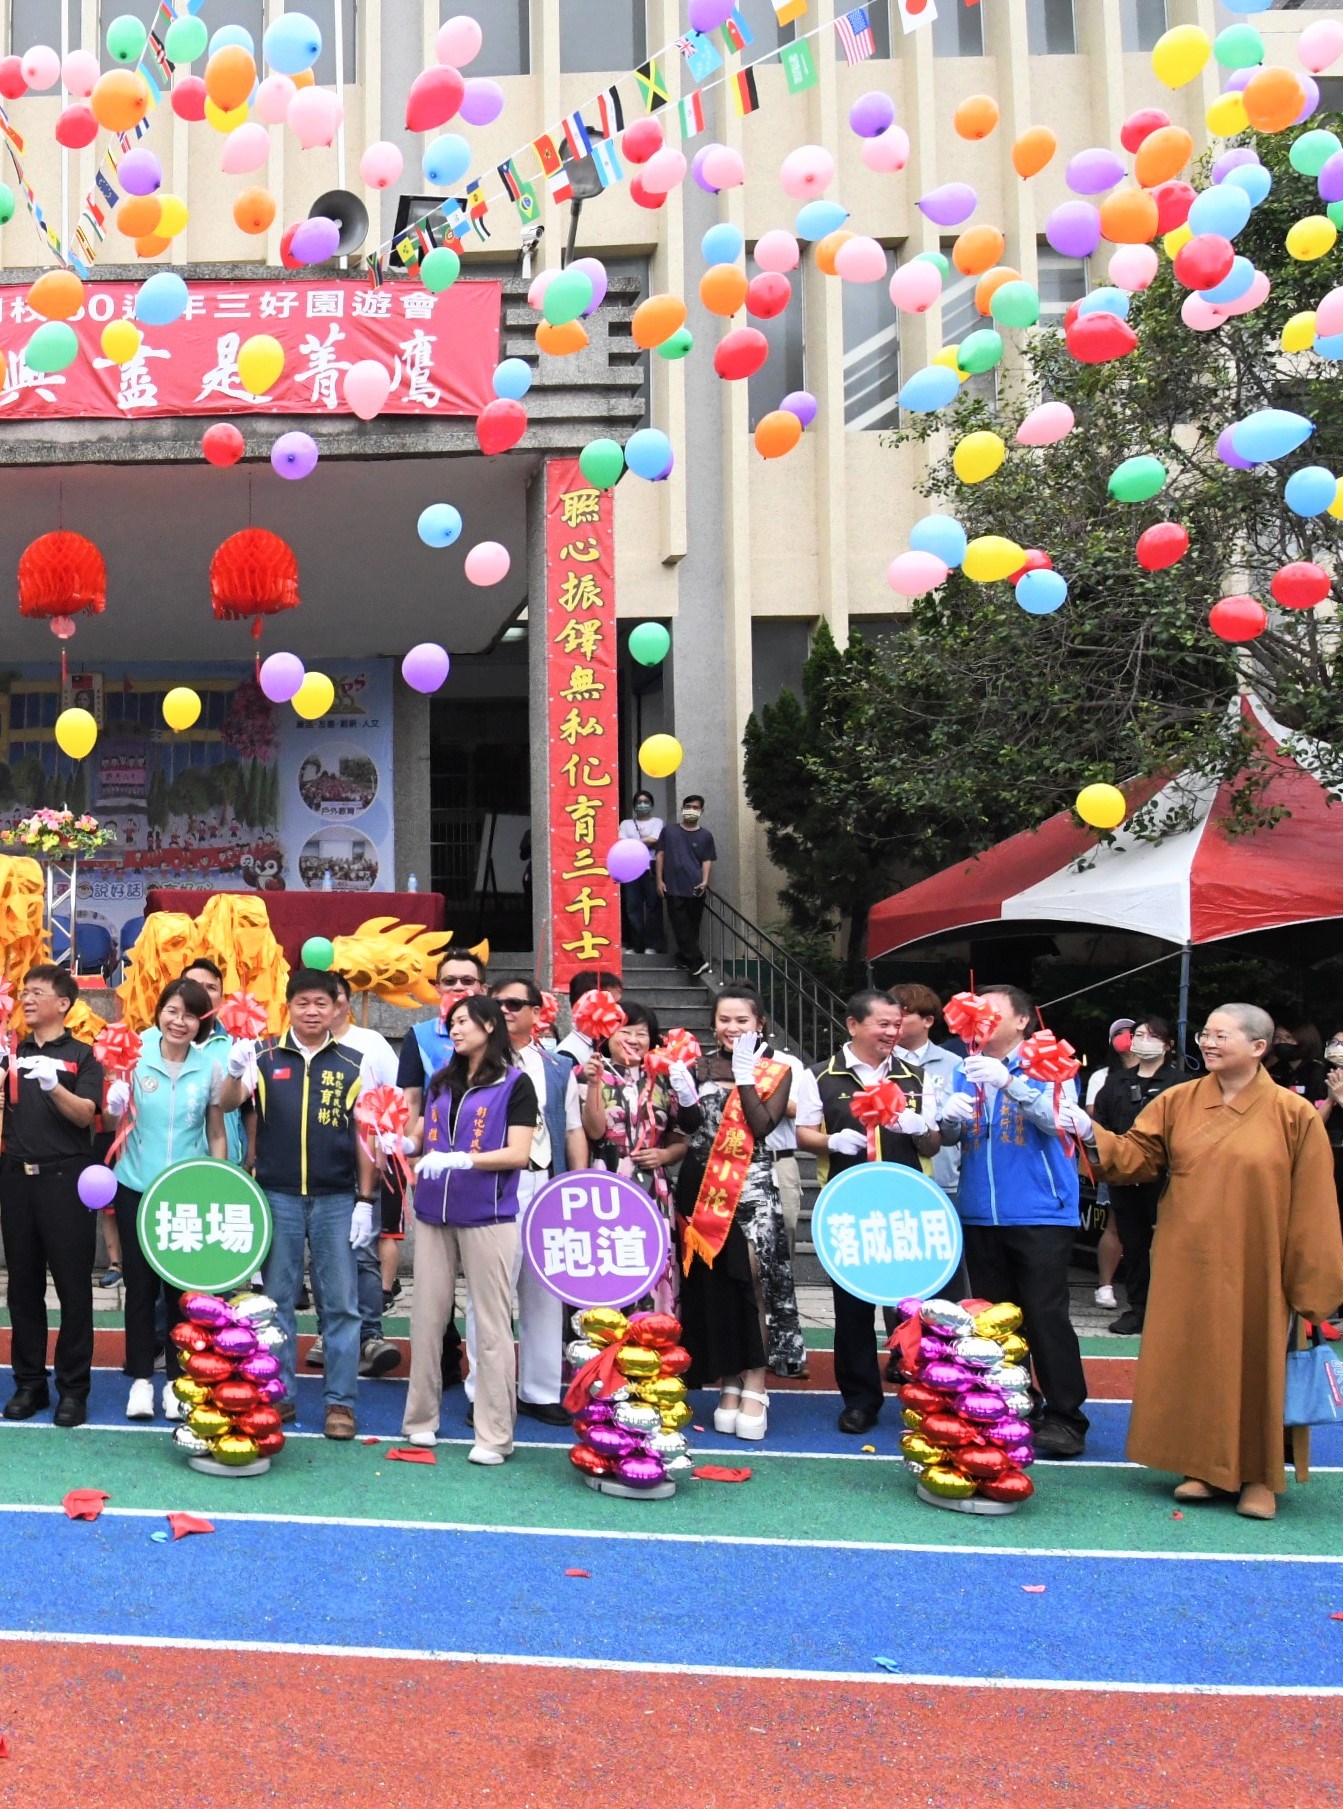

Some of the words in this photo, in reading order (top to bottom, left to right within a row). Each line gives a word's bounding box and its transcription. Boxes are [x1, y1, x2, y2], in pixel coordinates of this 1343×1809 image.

[93, 882, 143, 899] 說好話
[318, 1069, 335, 1126] 張育彬
[155, 1201, 254, 1254] 操場
[560, 1186, 621, 1221] PU
[541, 1225, 651, 1277] 跑道
[826, 1209, 954, 1267] 落成啟用
